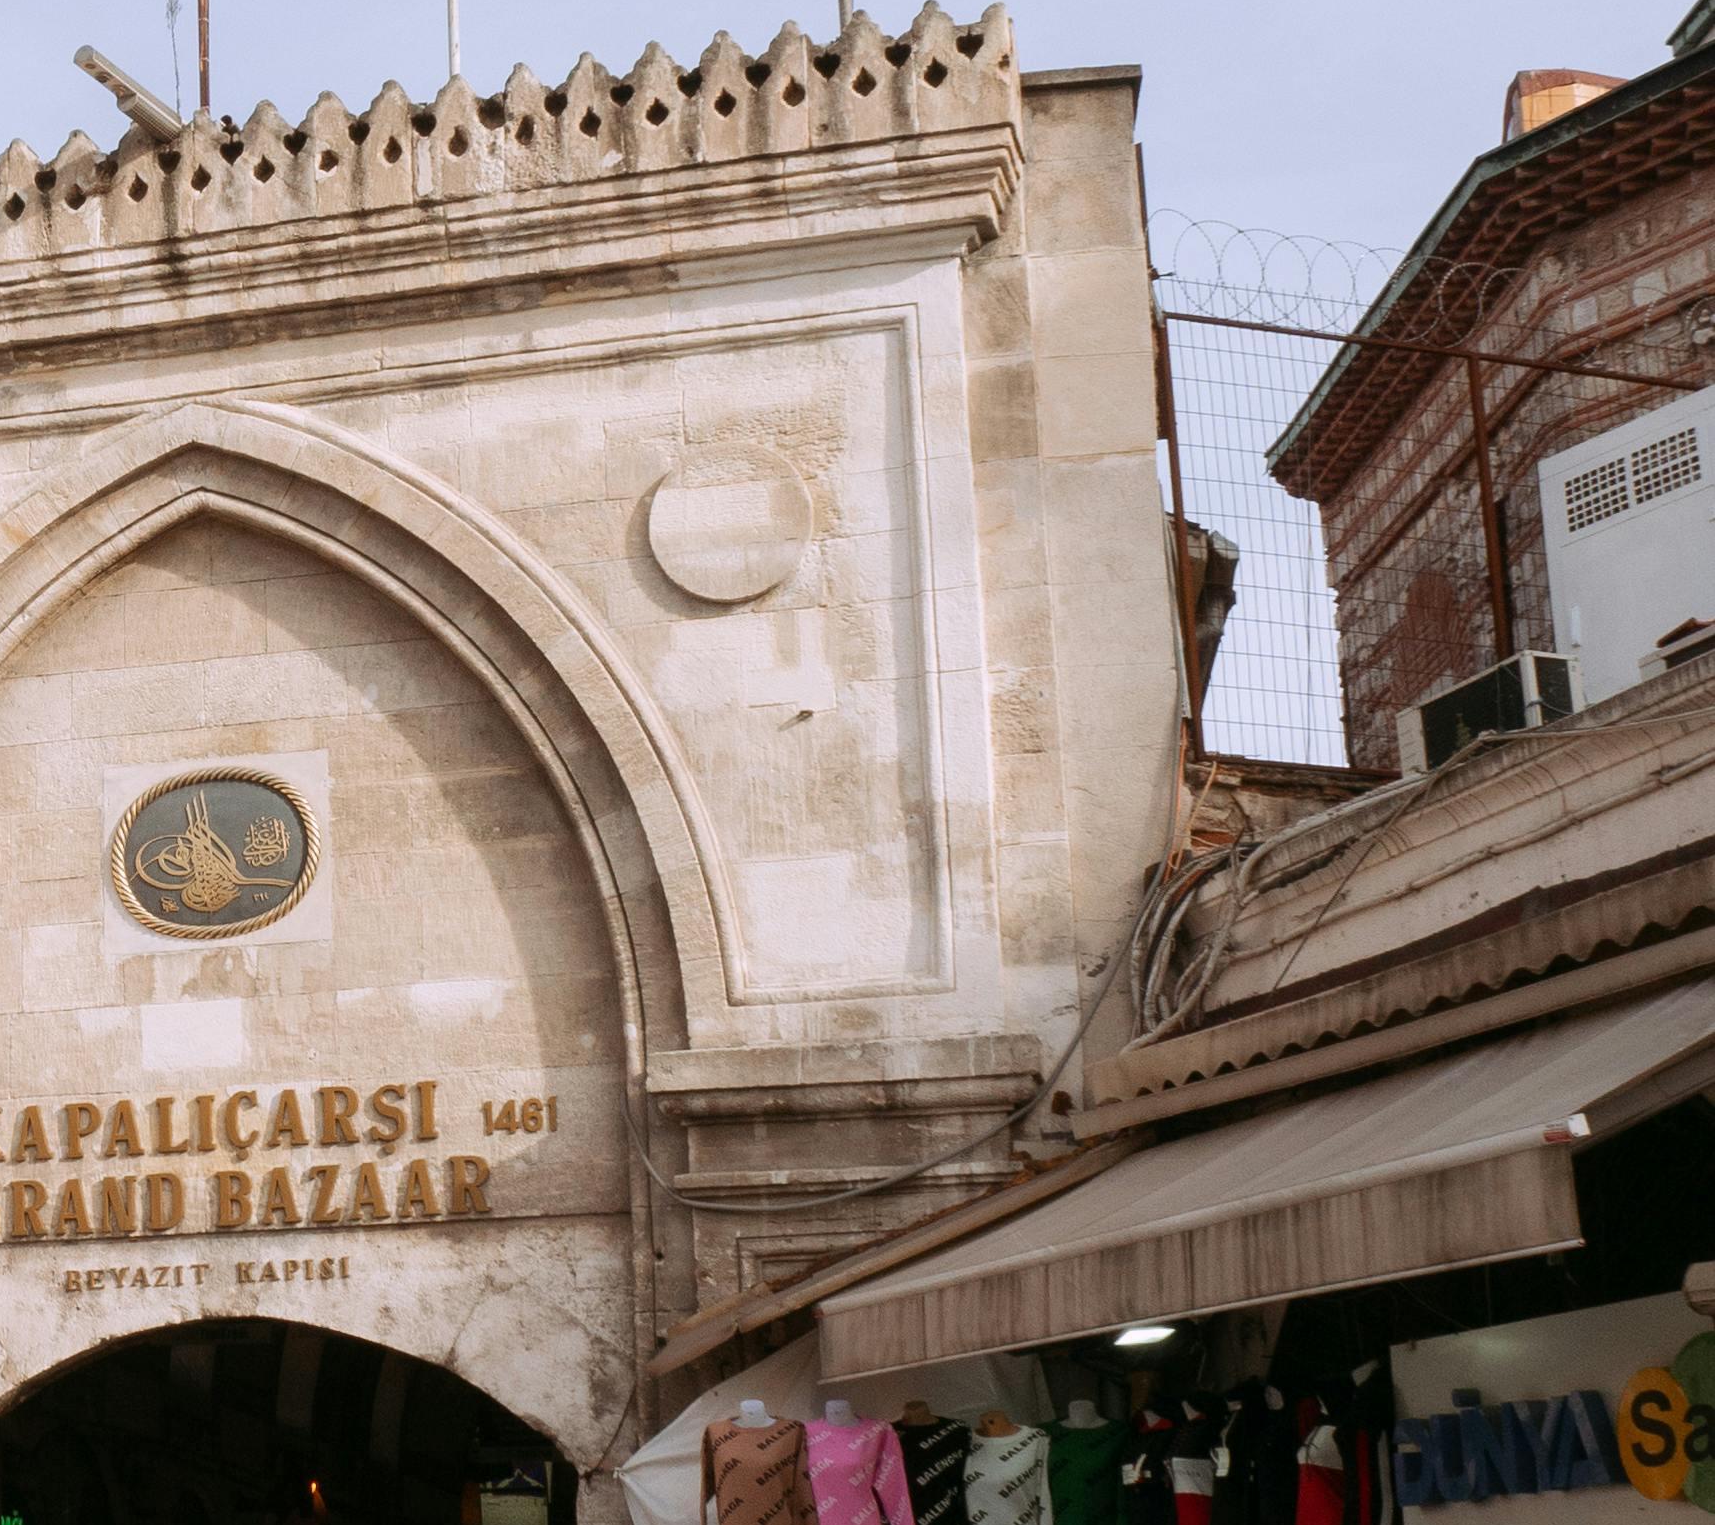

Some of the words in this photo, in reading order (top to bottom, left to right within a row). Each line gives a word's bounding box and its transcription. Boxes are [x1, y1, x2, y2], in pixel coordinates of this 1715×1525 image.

[481, 1095, 558, 1136] 1461
[214, 1154, 492, 1231] BAZAAR
[64, 1263, 209, 1294] BEYAZIT
[236, 1256, 352, 1286] KAPISI
